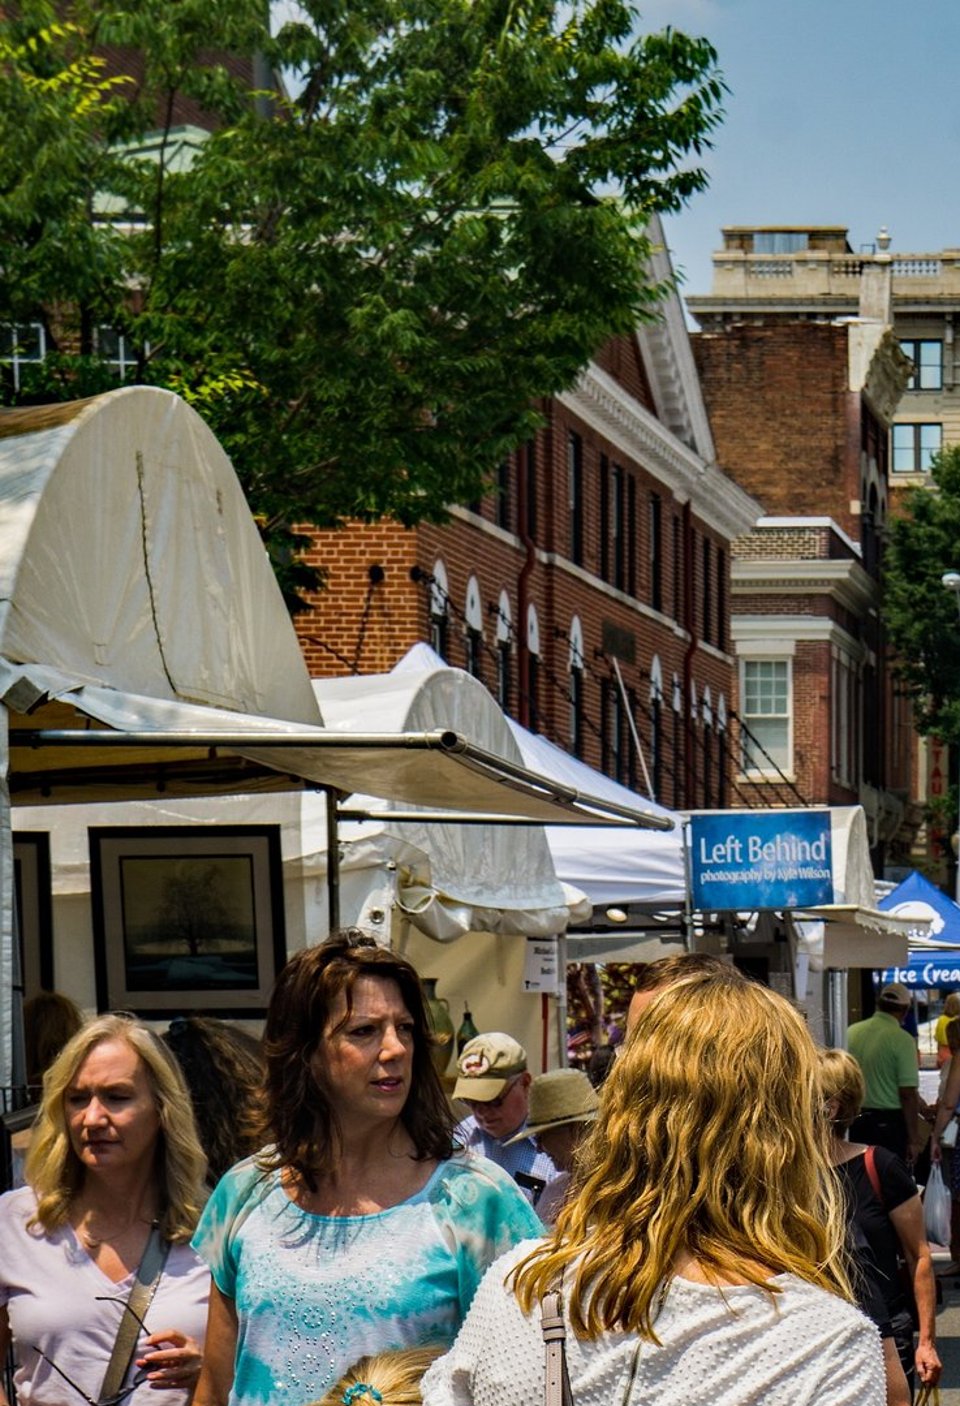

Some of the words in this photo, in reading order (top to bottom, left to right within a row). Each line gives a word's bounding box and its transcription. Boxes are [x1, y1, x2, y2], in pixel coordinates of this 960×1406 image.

[700, 835, 743, 864] Left
[748, 832, 827, 863] Behind
[700, 868, 761, 885] photography
[764, 868, 777, 884] by
[798, 866, 831, 880] Wilson
[893, 967, 918, 984] Ice
